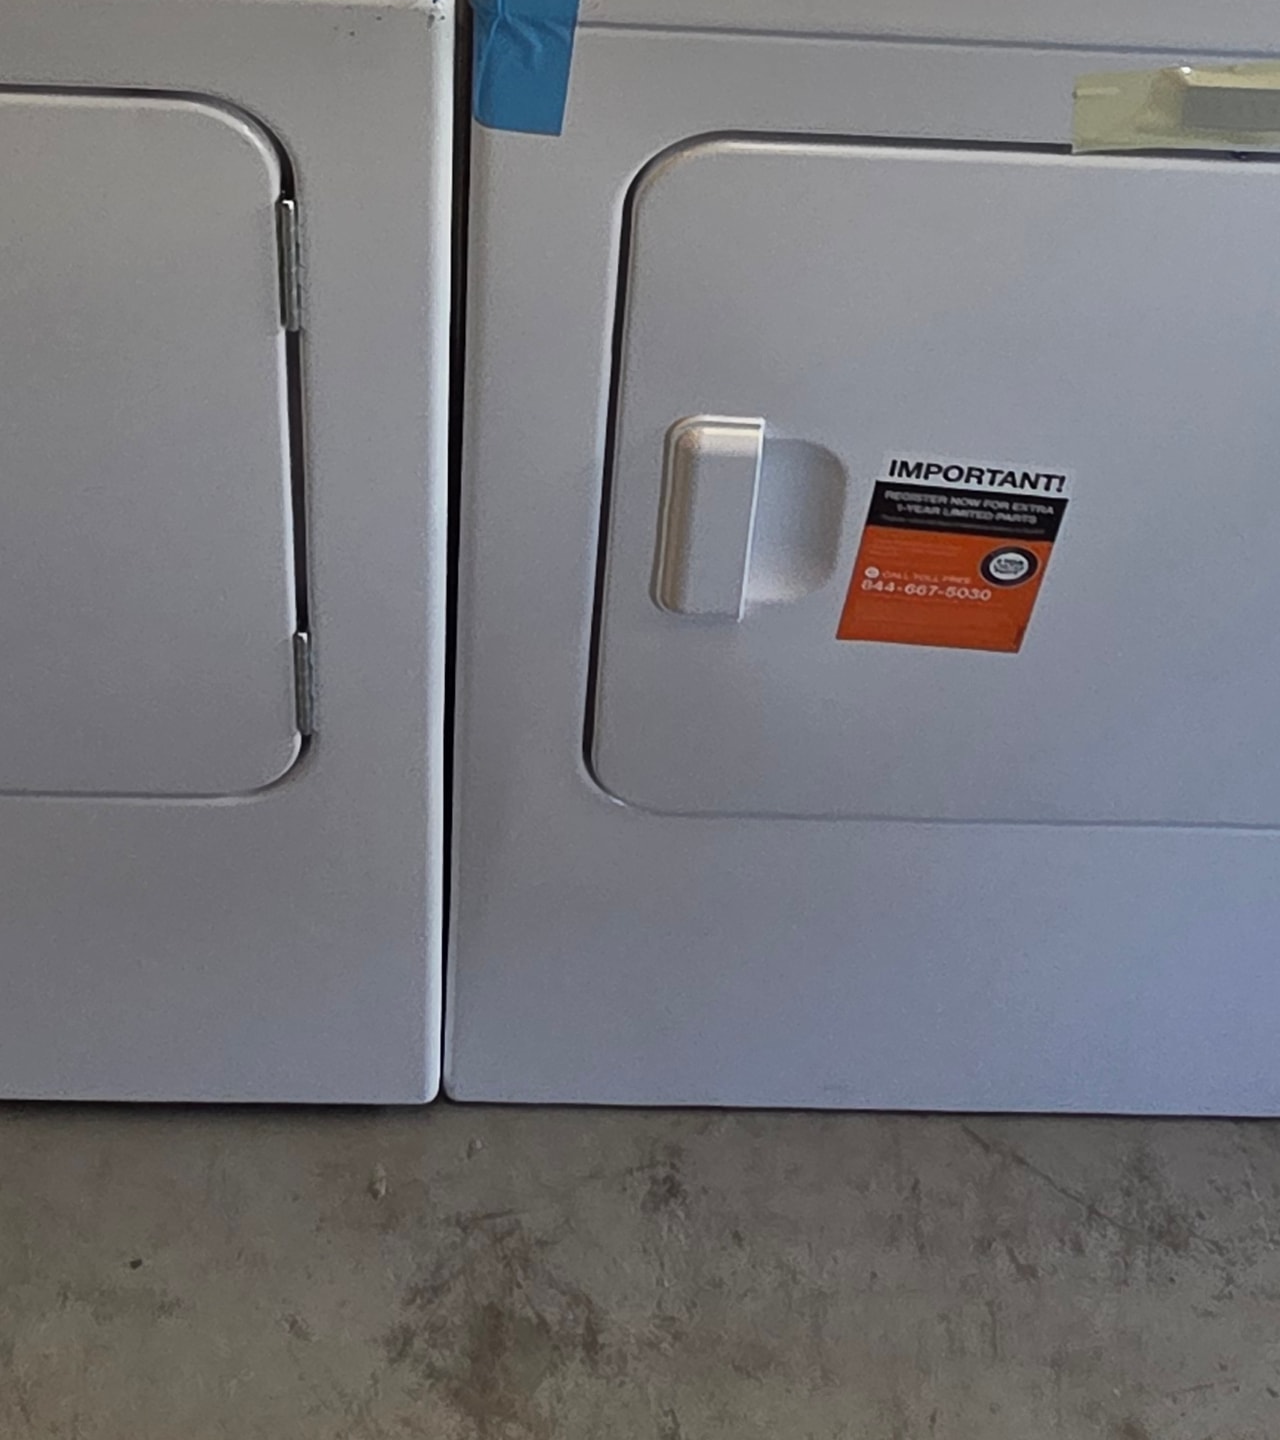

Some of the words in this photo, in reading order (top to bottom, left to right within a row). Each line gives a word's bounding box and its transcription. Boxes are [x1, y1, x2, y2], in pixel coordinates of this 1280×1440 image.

[889, 459, 1066, 493] IMPORTANT!
[884, 490, 949, 505] REGISTER
[951, 495, 981, 508] NOW
[983, 498, 1010, 511] FOR
[1012, 500, 1055, 516] EXTRA
[943, 506, 993, 522] LIMITED
[995, 511, 1037, 525] PARTS
[861, 579, 992, 601] 844-667-5030
